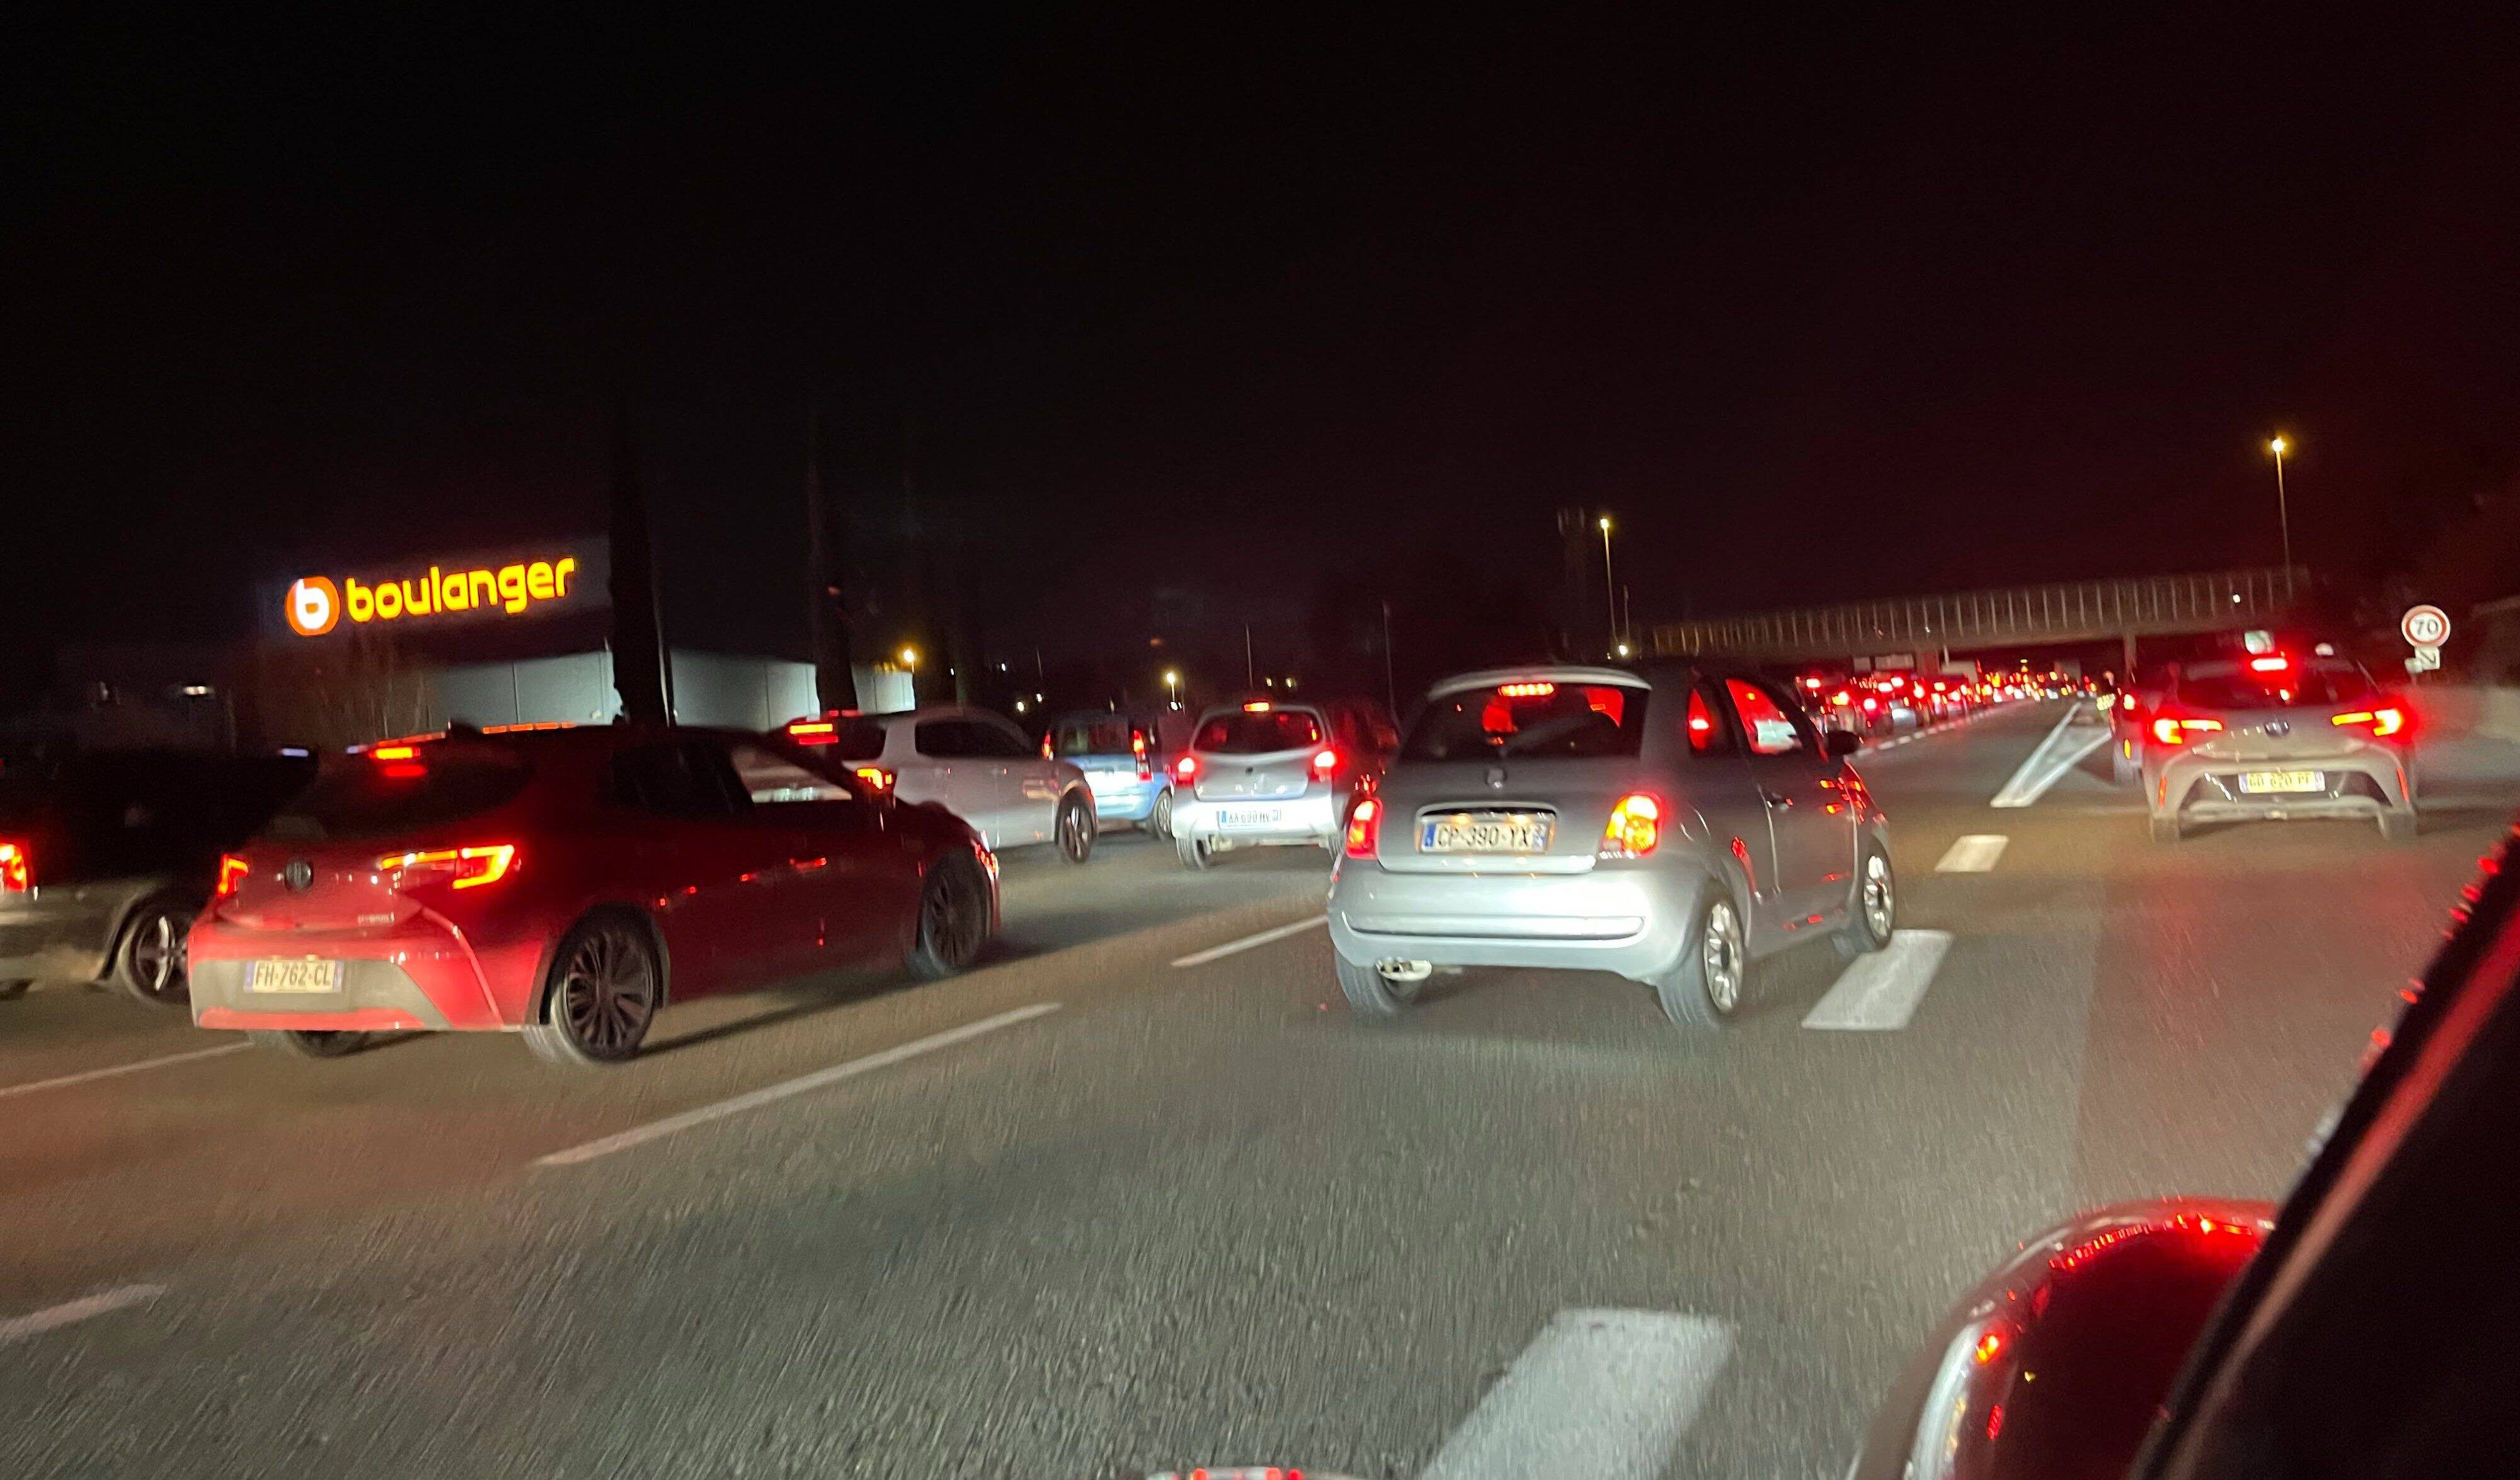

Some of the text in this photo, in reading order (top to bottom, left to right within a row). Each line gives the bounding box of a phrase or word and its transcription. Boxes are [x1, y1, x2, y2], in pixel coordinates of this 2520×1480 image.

[345, 557, 575, 622] boulanger
[2414, 619, 2439, 636] 70
[255, 961, 331, 987] FH-762-CL
